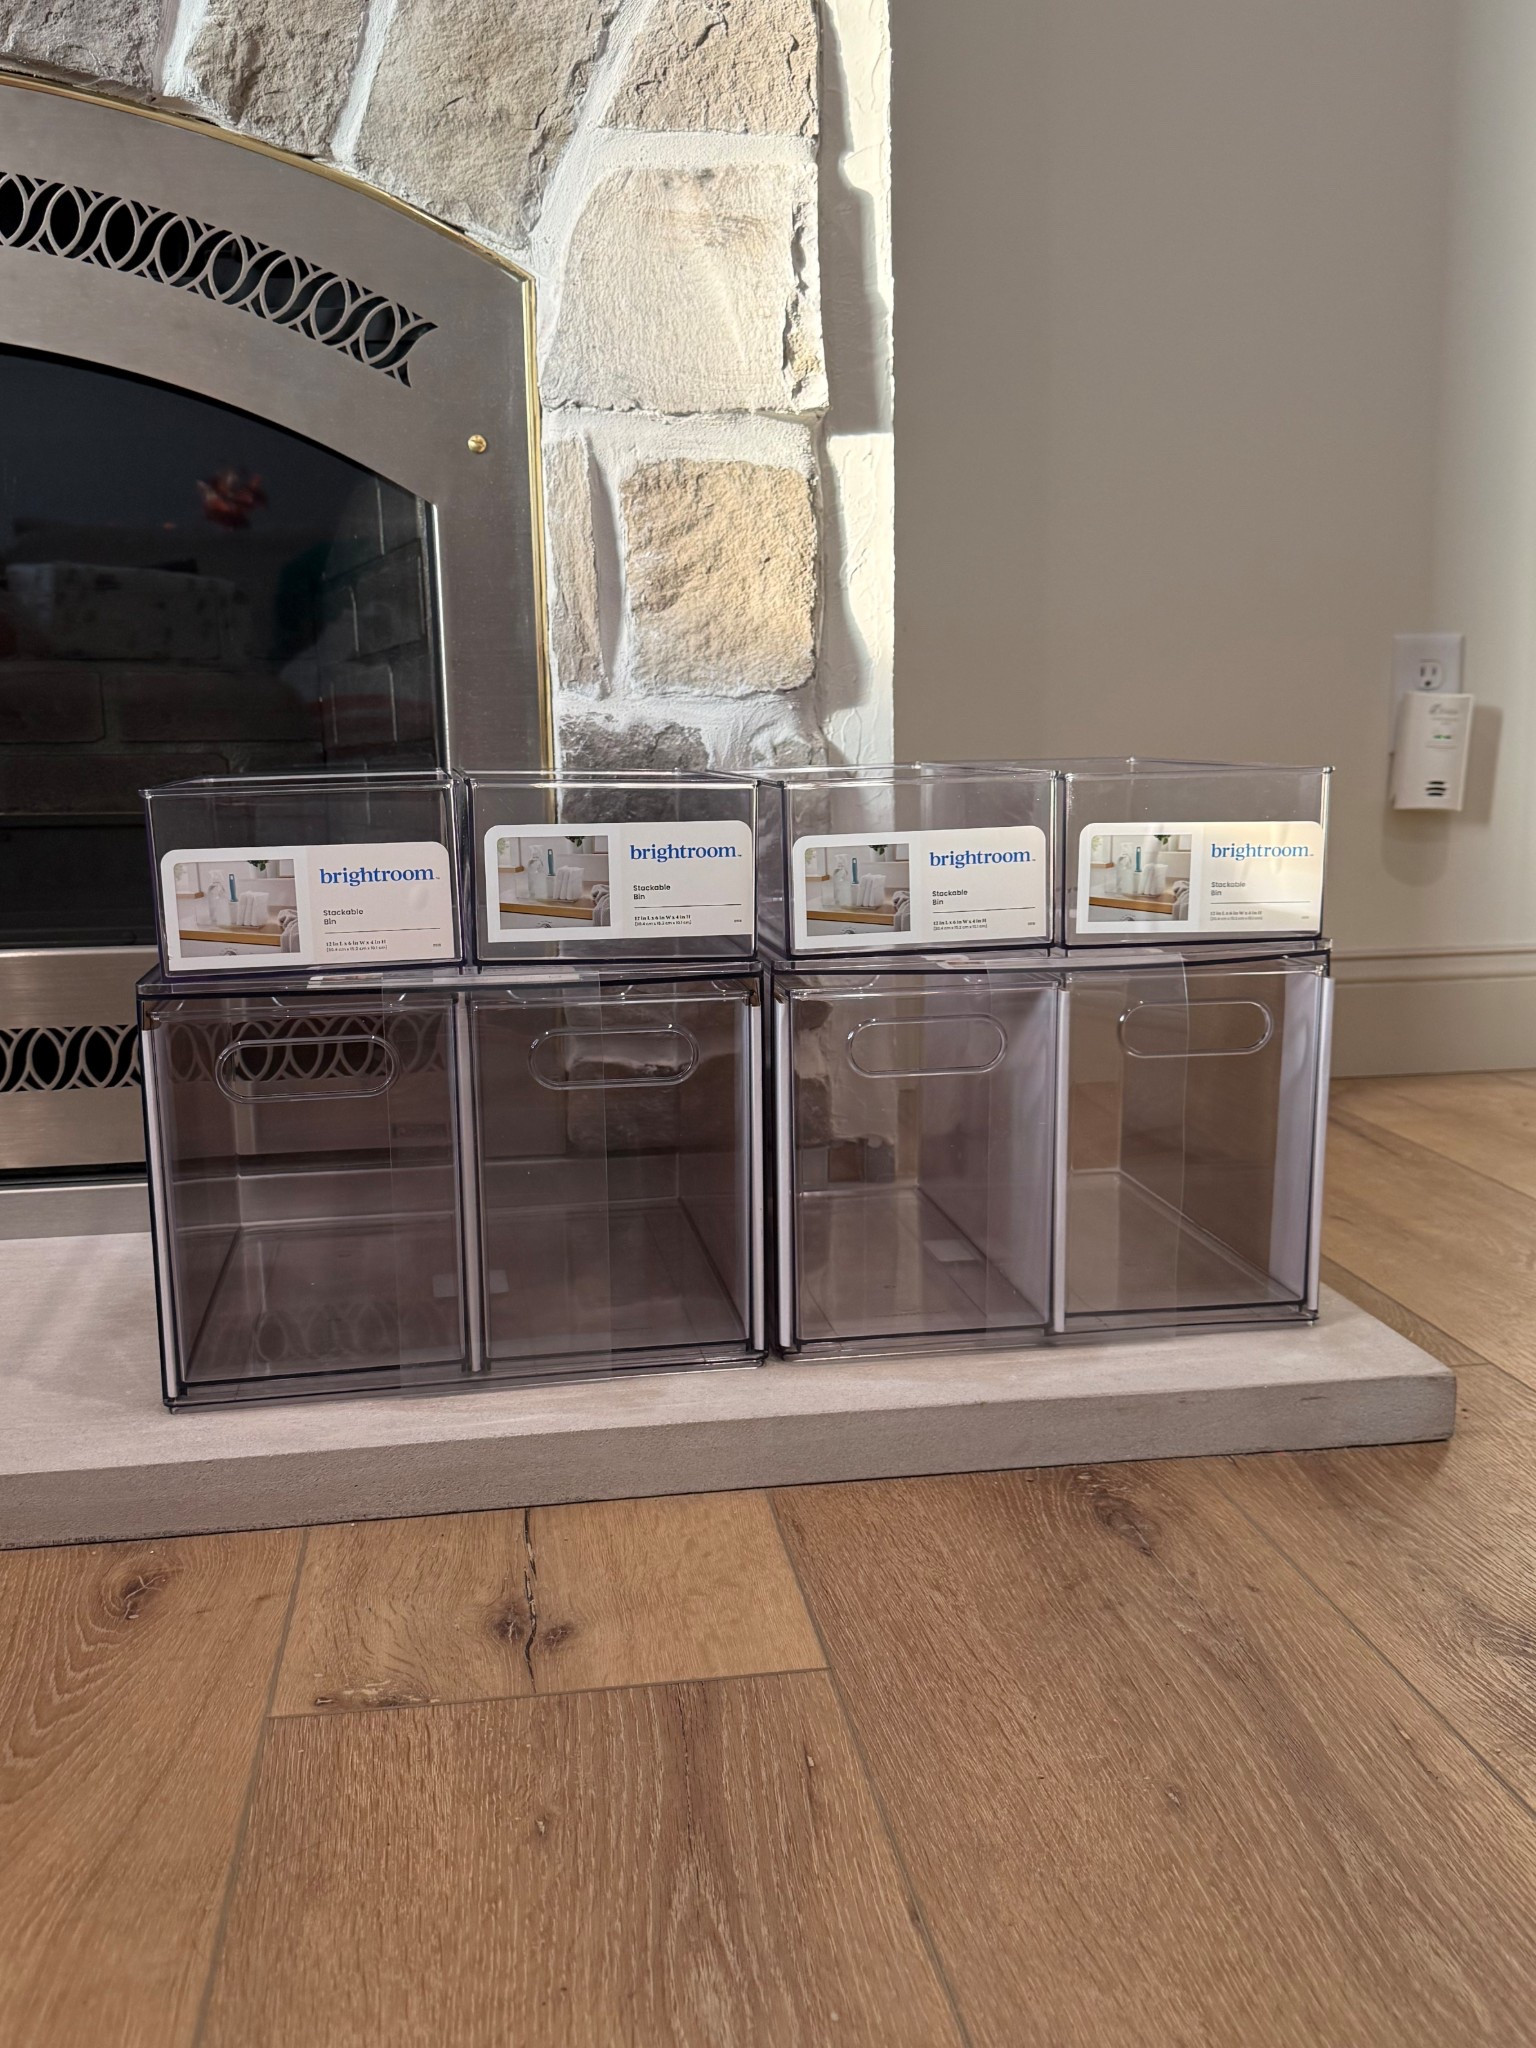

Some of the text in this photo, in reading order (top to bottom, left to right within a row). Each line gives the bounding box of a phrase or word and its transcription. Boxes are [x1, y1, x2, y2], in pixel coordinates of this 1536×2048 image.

[630, 844, 737, 862] brightroom
[930, 850, 1030, 868] brightroom
[1212, 844, 1308, 860] brightroom
[319, 866, 435, 887] brightroom
[323, 908, 364, 917] Stackable
[324, 918, 337, 926] Bin
